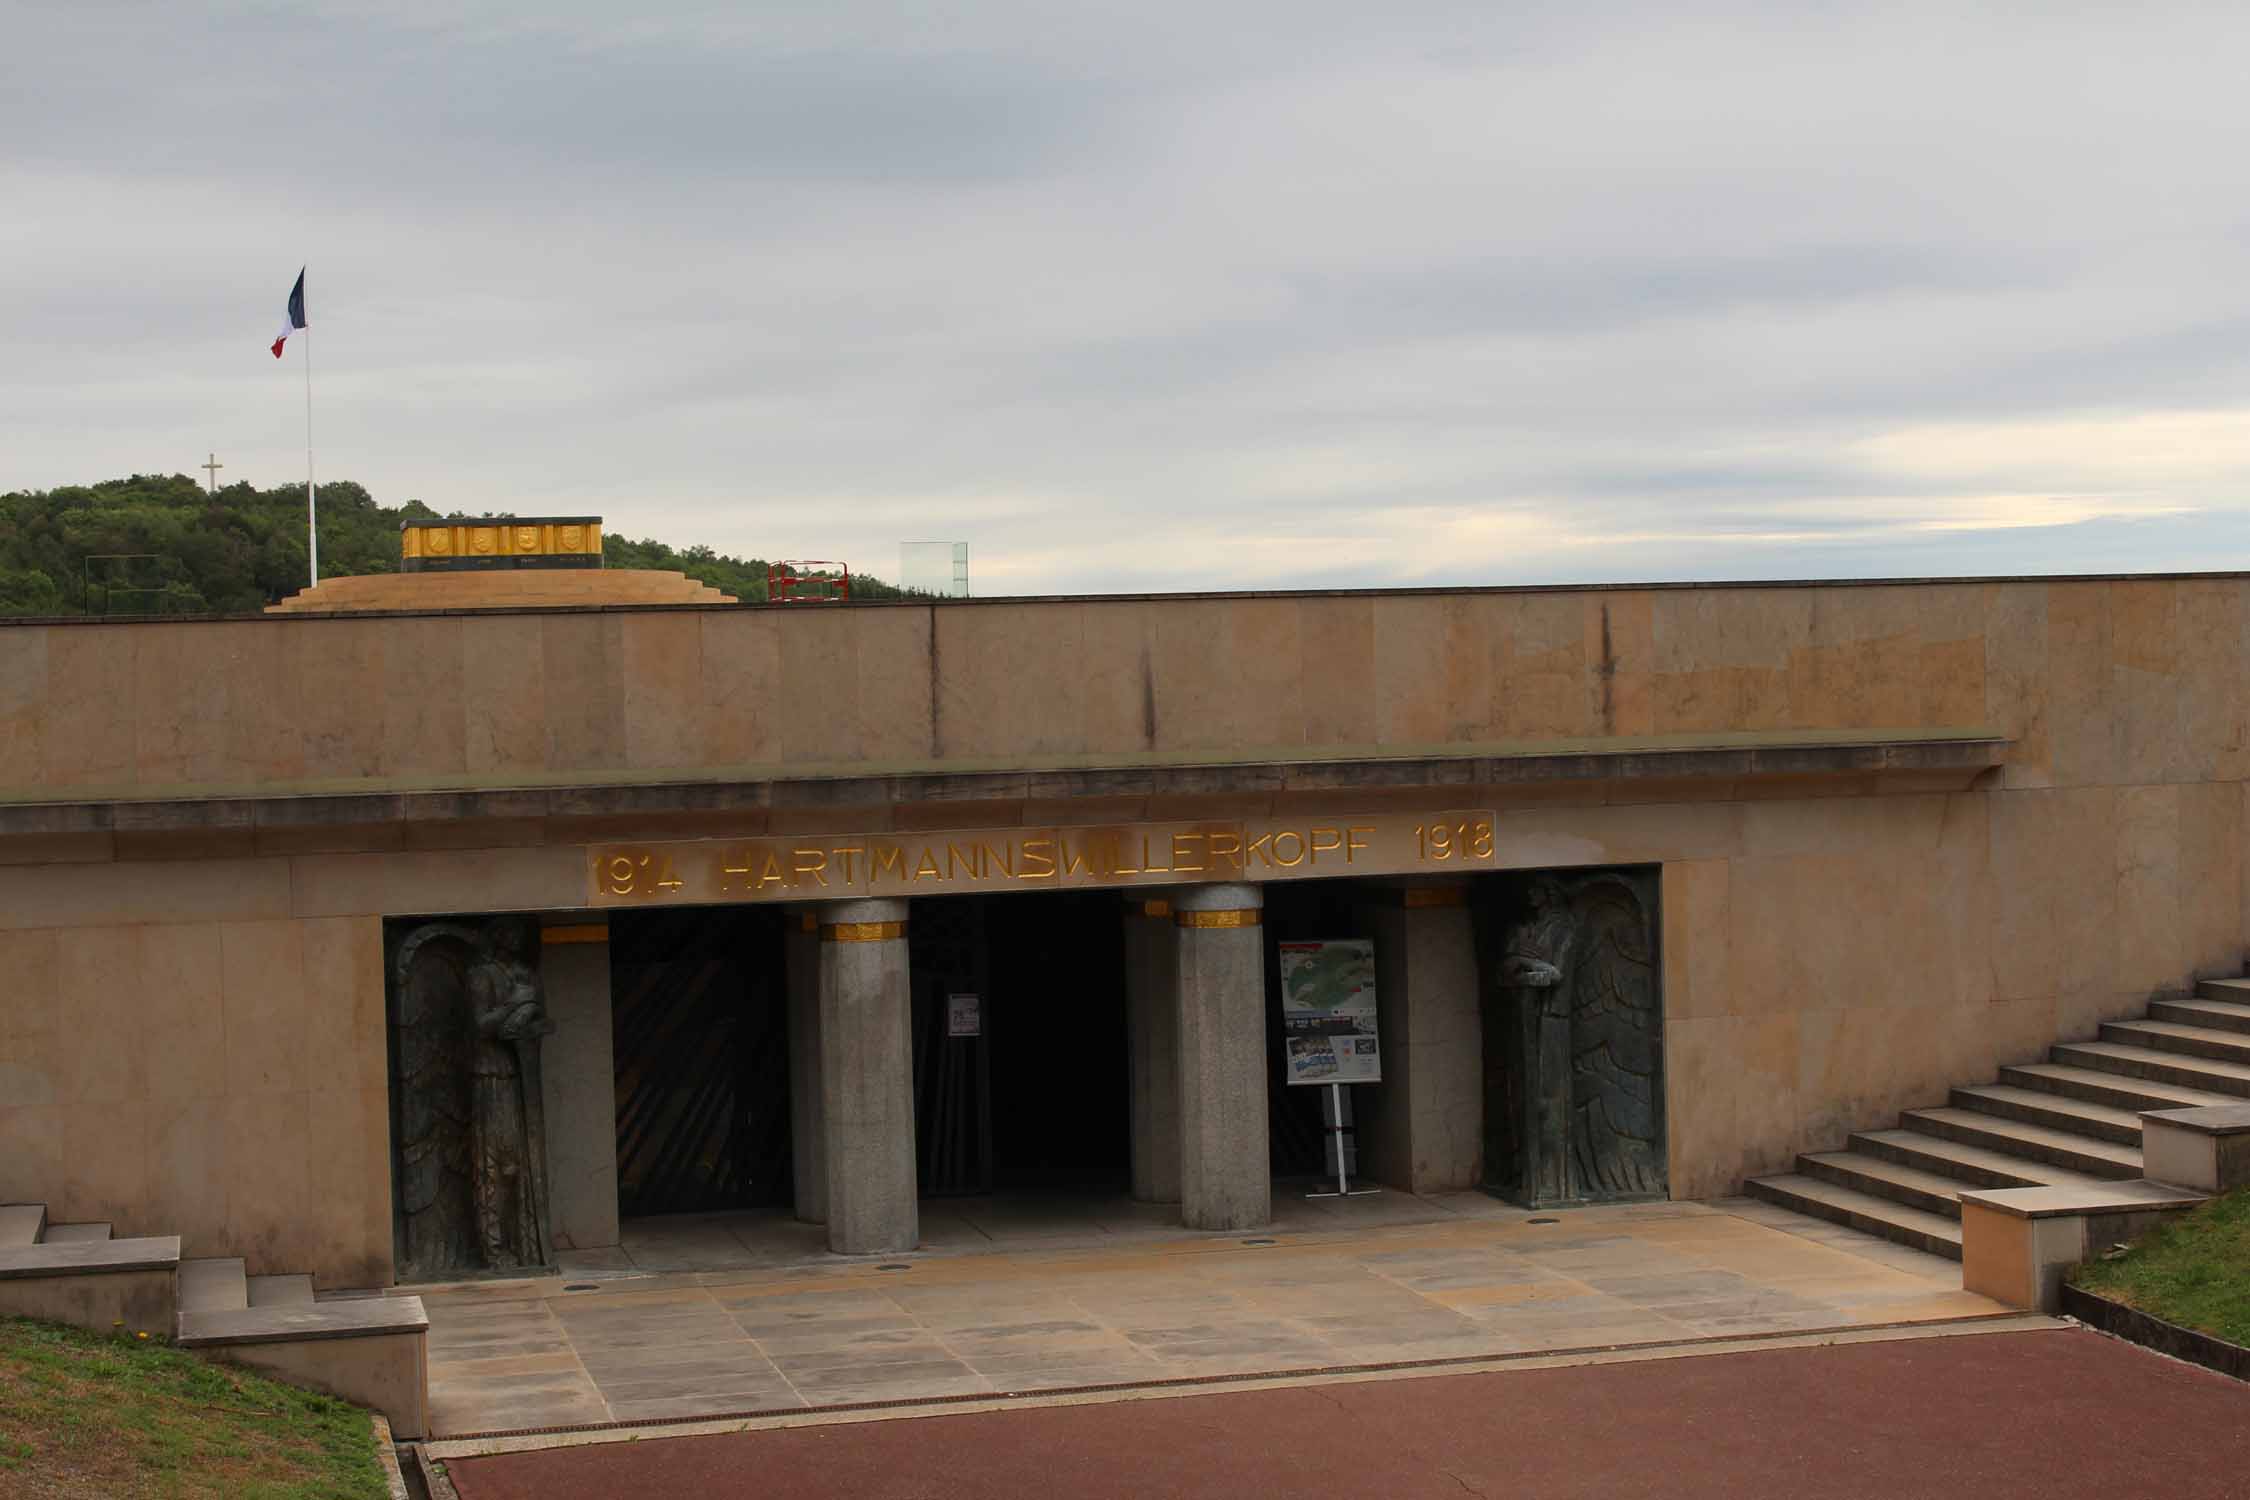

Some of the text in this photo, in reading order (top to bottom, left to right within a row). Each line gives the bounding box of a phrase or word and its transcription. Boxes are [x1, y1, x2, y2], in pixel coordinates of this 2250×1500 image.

[593, 822, 1495, 896] 1914 HARTMANNSWILLERKOPF 1918
